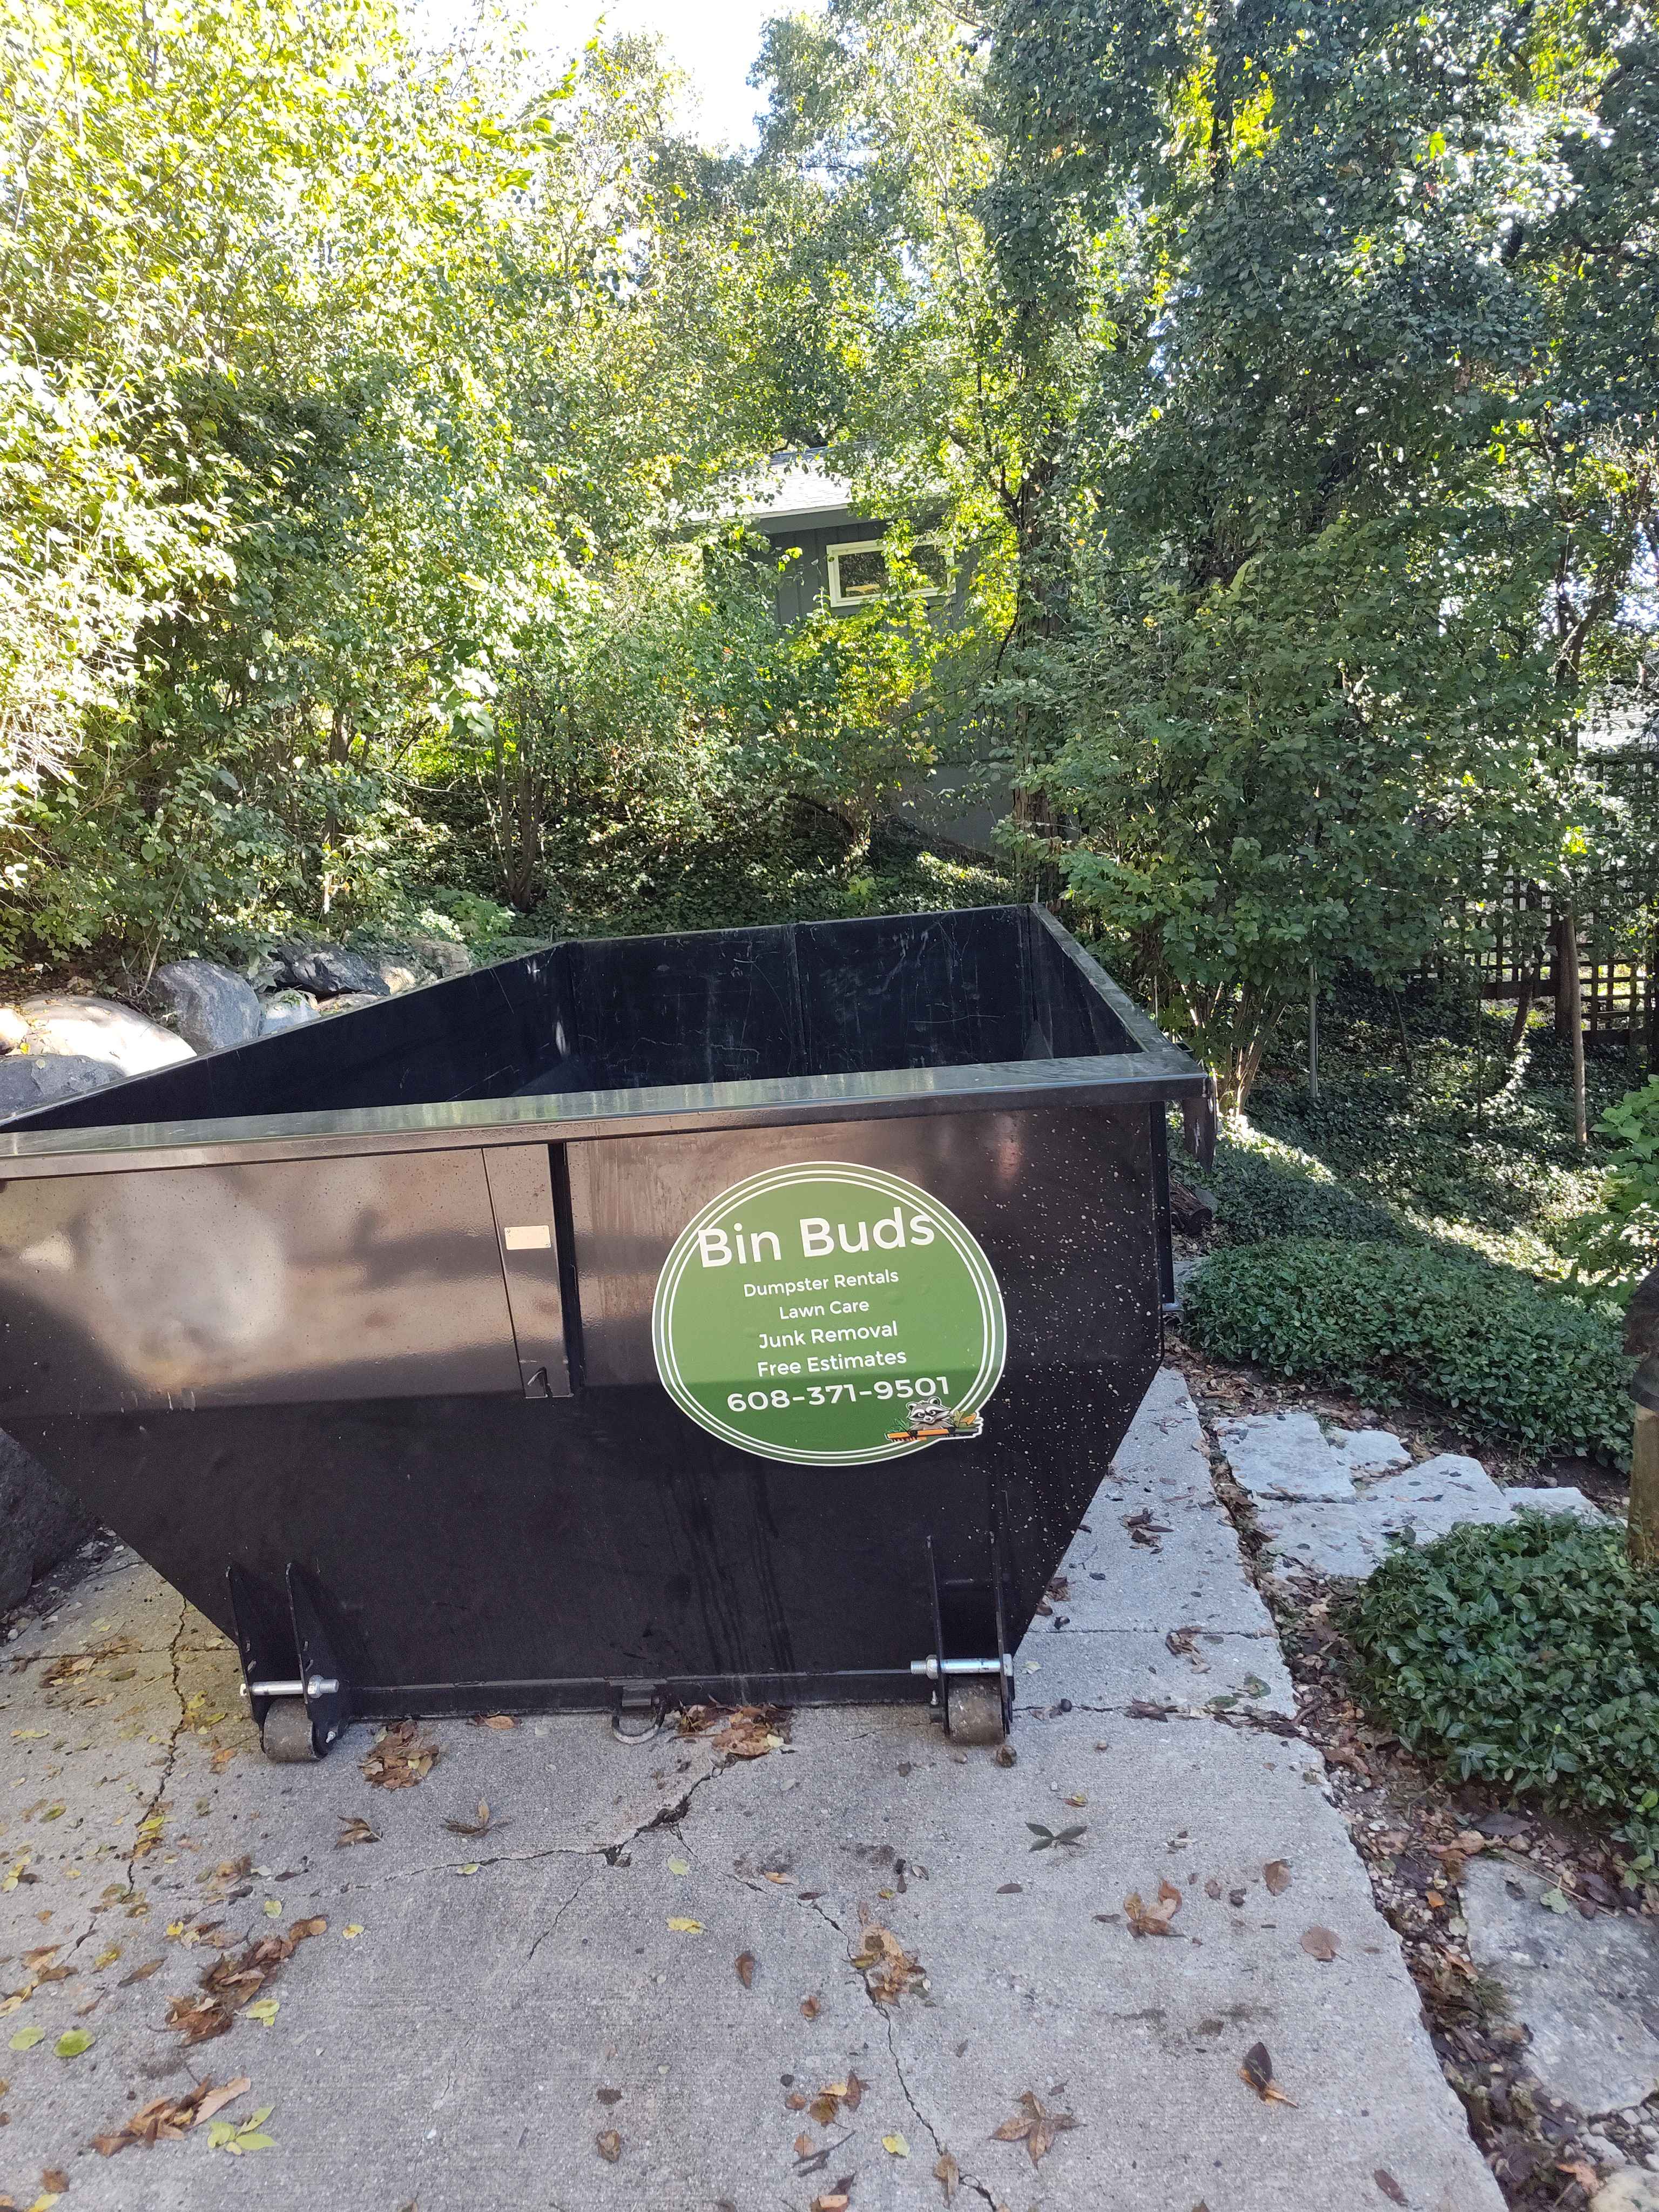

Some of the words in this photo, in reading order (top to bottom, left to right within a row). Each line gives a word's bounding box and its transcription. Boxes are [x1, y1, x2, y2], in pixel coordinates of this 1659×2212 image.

[698, 1223, 782, 1268] Bin
[799, 1206, 935, 1258] Buds
[743, 1276, 829, 1297] Dumpster
[834, 1269, 899, 1289] Rentals
[779, 1300, 825, 1320] Lawn
[830, 1298, 869, 1316] Care
[758, 1330, 806, 1349] Junk
[811, 1320, 898, 1345] Removal
[757, 1359, 801, 1377] Free
[807, 1350, 907, 1372] Estimates
[727, 1375, 950, 1413] 608-371-9501
